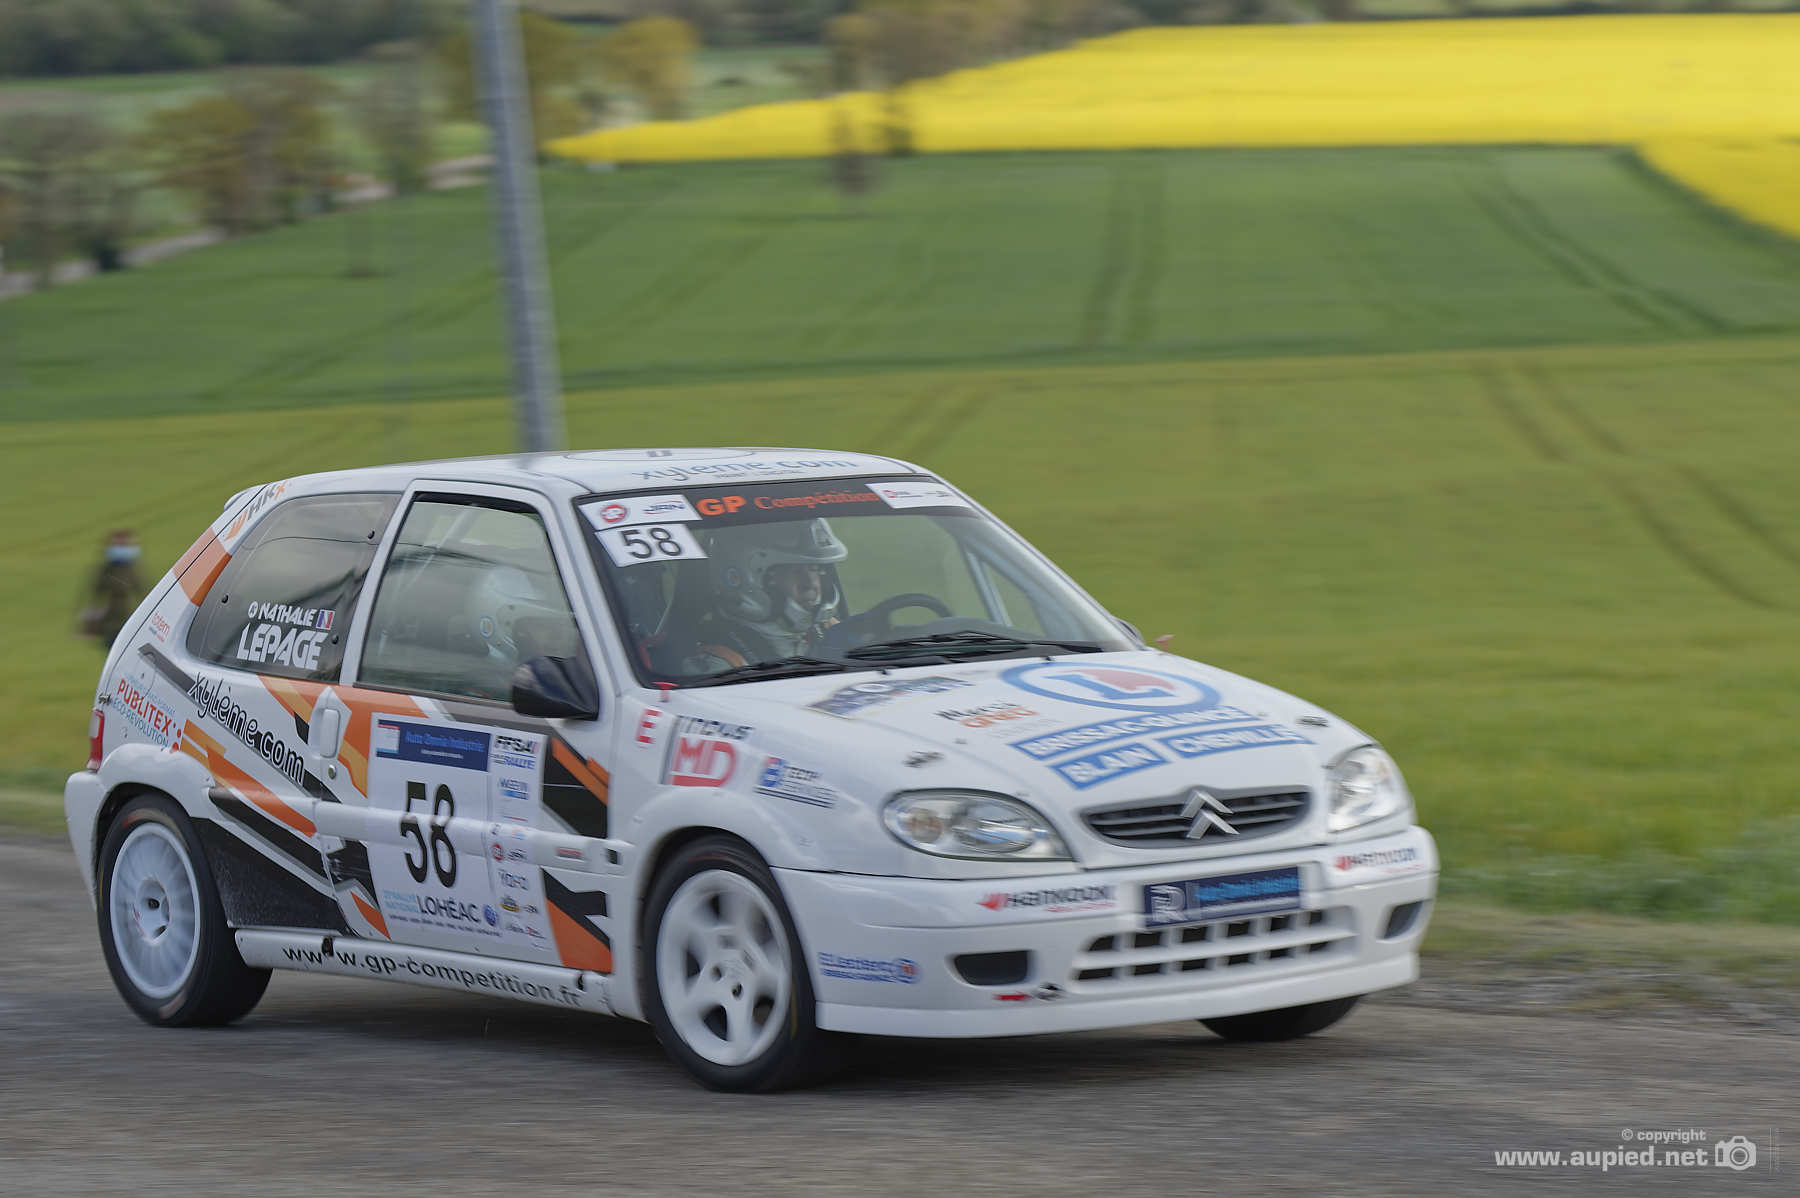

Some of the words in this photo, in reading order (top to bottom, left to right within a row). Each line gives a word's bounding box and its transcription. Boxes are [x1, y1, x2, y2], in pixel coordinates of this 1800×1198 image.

[696, 497, 748, 518] GP
[618, 527, 682, 559] 58
[258, 602, 317, 627] NATHALIE
[236, 622, 329, 671] LEPAGE
[116, 679, 173, 737] PUBLITEX
[1062, 744, 1163, 785] BLAIN
[400, 781, 456, 888] 58
[416, 894, 482, 924] LOHÉAC
[281, 944, 580, 1006] www.gp-competition.fr
